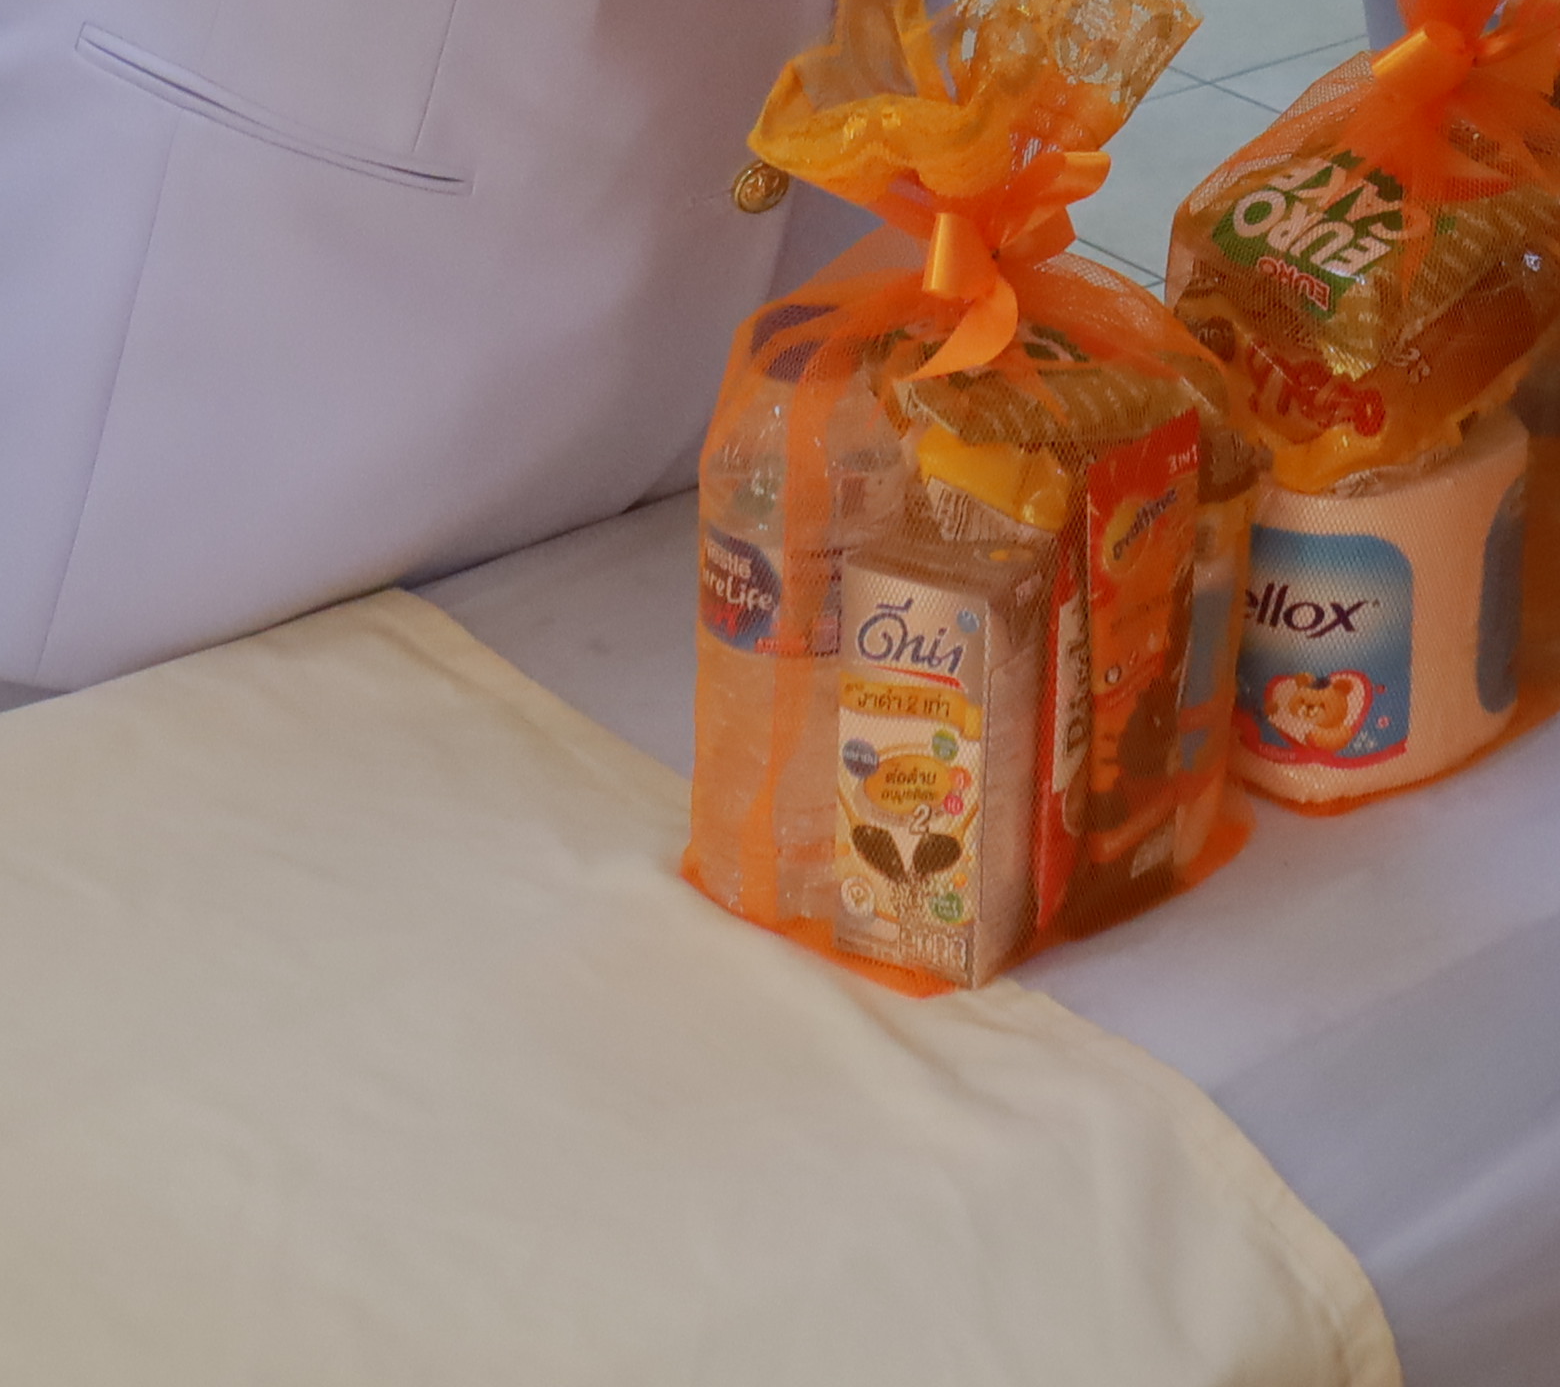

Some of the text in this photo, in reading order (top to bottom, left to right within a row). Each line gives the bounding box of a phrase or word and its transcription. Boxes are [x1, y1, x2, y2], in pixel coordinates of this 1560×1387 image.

[1231, 189, 1393, 277] EURO
[1256, 255, 1331, 312] EURO
[856, 597, 964, 674] ดีน่า
